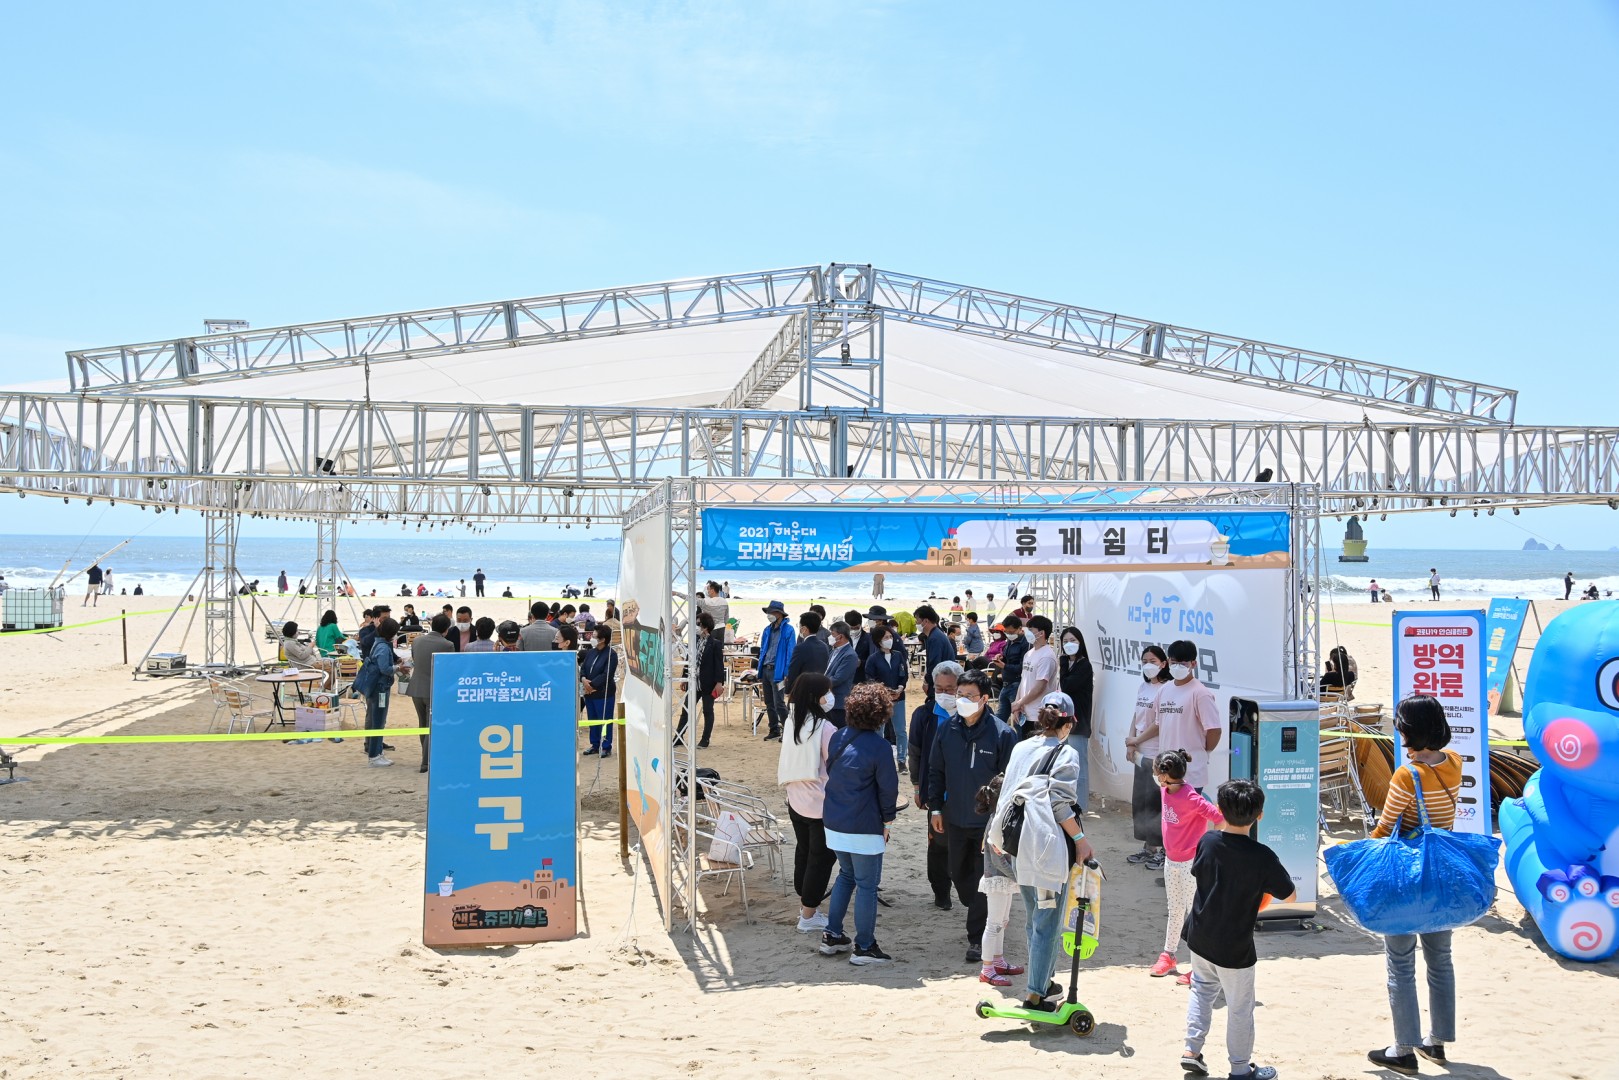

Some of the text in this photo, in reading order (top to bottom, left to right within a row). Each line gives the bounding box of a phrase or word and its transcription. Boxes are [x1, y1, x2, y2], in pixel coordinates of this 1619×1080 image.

[739, 521, 817, 541] 2021 해운대
[737, 536, 853, 561] 모래작품전시회
[1416, 628, 1438, 636] 코로나19
[1413, 643, 1464, 669] 방역
[458, 671, 522, 687] 2021 해운대
[1413, 672, 1464, 698] 완료
[457, 681, 552, 703] 모래작품전시회
[475, 724, 525, 850] 입구
